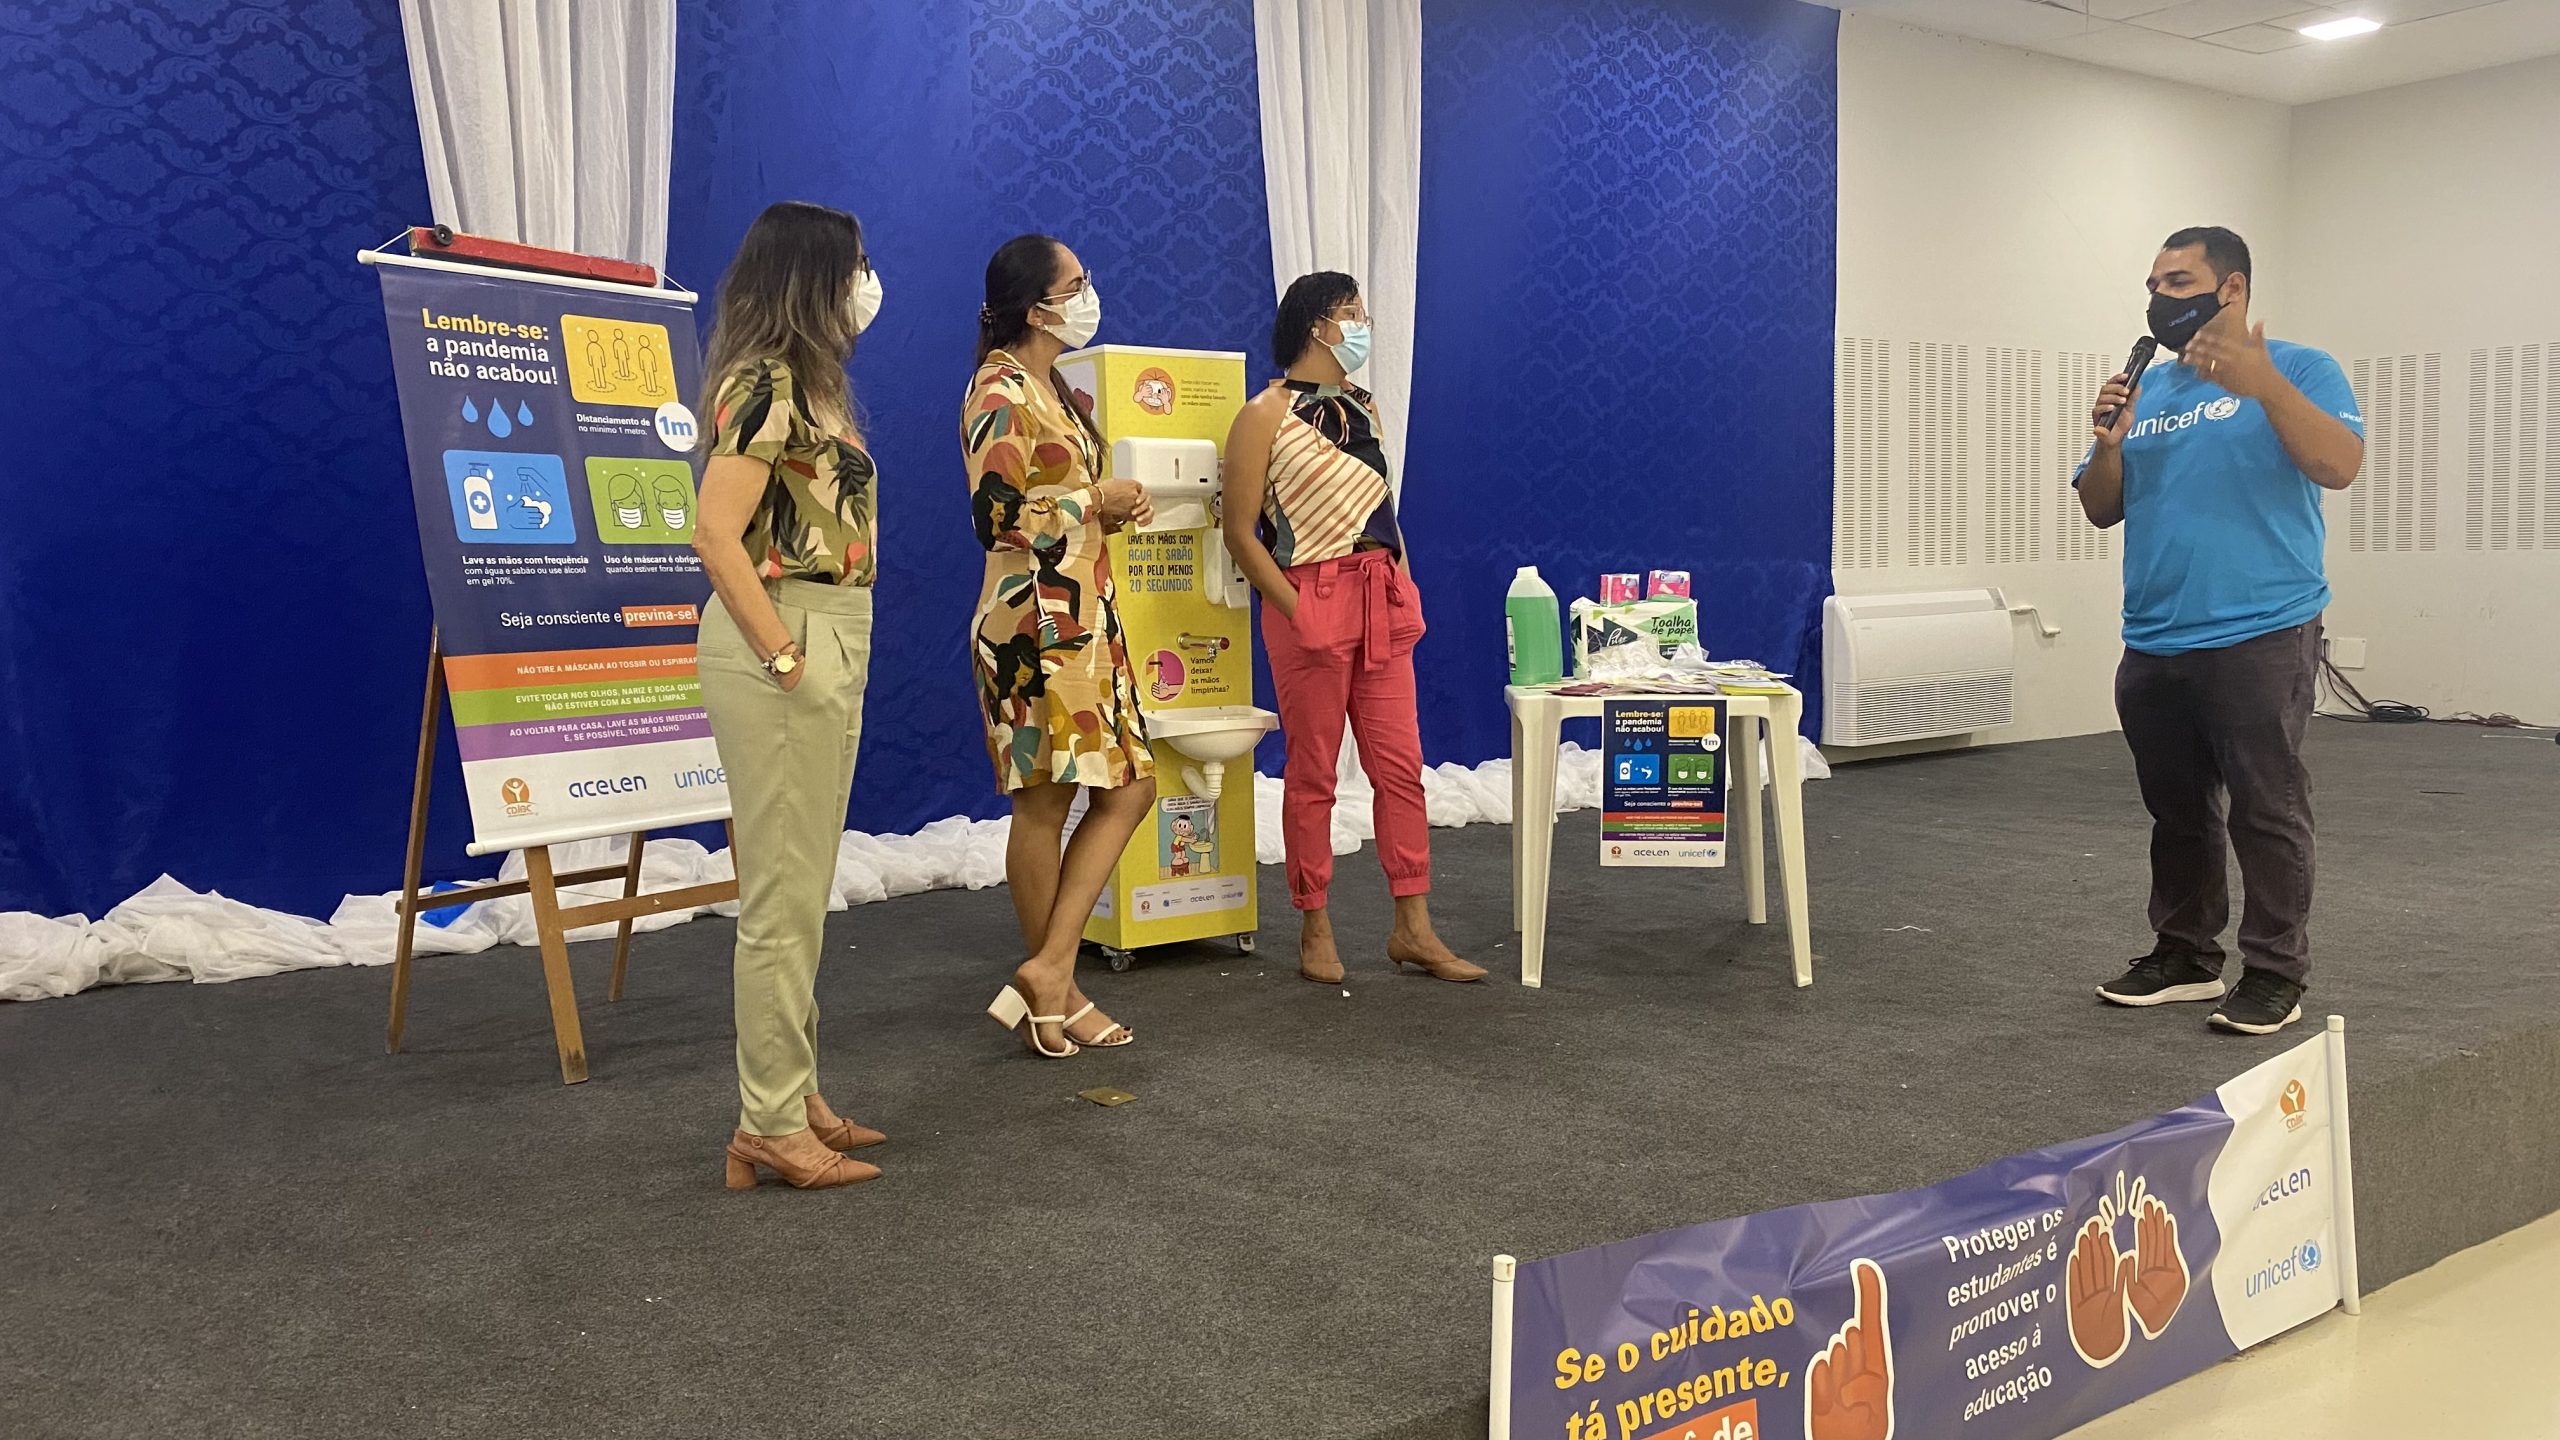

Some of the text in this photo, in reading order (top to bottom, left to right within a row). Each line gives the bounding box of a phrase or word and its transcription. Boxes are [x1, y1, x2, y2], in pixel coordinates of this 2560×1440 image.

[422, 308, 549, 340] Lembre-se:
[426, 337, 549, 362] a pandemia
[430, 357, 558, 385] não acabou!
[576, 414, 651, 427] Distanciamento de
[659, 415, 693, 436] 1m
[2127, 401, 2206, 440] unicef
[1127, 533, 1194, 545] LAVE AS MÃOS COM
[462, 555, 589, 566] Lave as mãos com frequência
[603, 555, 620, 564] Uso
[622, 555, 633, 564] de
[634, 554, 667, 564] máscara
[668, 555, 674, 564] é
[1128, 546, 1193, 561] ÁGUA E SABÃO
[464, 565, 587, 577] com água e sabão ou use álcool
[605, 565, 634, 574] quando
[634, 565, 658, 573] estiver
[658, 564, 674, 573] fora
[1128, 564, 1194, 577] POR PELO MENOS
[466, 577, 481, 585] em
[481, 577, 494, 587] gel
[1130, 578, 1193, 592] 20 SEGUNDOS
[500, 606, 697, 629] Seja consciente e previna-se!
[1650, 615, 1691, 628] Toalha
[1650, 626, 1662, 635] de
[516, 665, 536, 675] NÃO
[536, 665, 556, 674] TIRE
[557, 665, 563, 673] A
[564, 662, 605, 672] MÁSCARA
[606, 661, 618, 670] AO
[619, 659, 647, 669] TOSSIR
[649, 658, 660, 667] OU
[1190, 656, 1215, 664] Vamos
[1190, 666, 1213, 675] deixar
[1200, 675, 1220, 684] mãos
[515, 695, 540, 704] EVITE
[540, 692, 569, 702] TOCAR
[570, 690, 589, 699] NOS
[622, 686, 646, 695] NARIZ
[647, 686, 653, 694] E
[654, 684, 676, 693] BOCA
[677, 682, 701, 692] QUAN
[1191, 684, 1230, 695] limpinhas?
[544, 693, 689, 712] NÃO ESTIVER COM AS MÃOS LIMPAS.
[1615, 710, 1664, 718] Lembre-se:
[509, 728, 522, 737] AO
[523, 725, 556, 735] VOLTAR
[556, 723, 579, 733] PARA
[606, 718, 627, 728] LAVE
[628, 718, 639, 727] AS
[640, 715, 664, 725] MÃOS
[665, 712, 708, 722] IMEDIATAM
[1615, 725, 1664, 733] não acabou!
[1622, 718, 1662, 727] pandemia
[574, 732, 585, 741] SE
[628, 726, 651, 735] TOME
[1703, 738, 1718, 746] 1m
[569, 775, 647, 798] acelen
[674, 764, 728, 789] unice
[1633, 847, 1707, 858] acelen unicef
[1941, 1208, 2064, 1263] Proteger os
[1947, 1234, 2058, 1308] estudantes é
[2245, 1246, 2299, 1298] unicef
[1949, 1283, 2057, 1352] promover o
[1554, 1294, 1795, 1390] Se o cuidado
[1965, 1322, 2042, 1380] acesso à
[1565, 1356, 1790, 1440] tá presente,
[1963, 1363, 2053, 1423] educação
